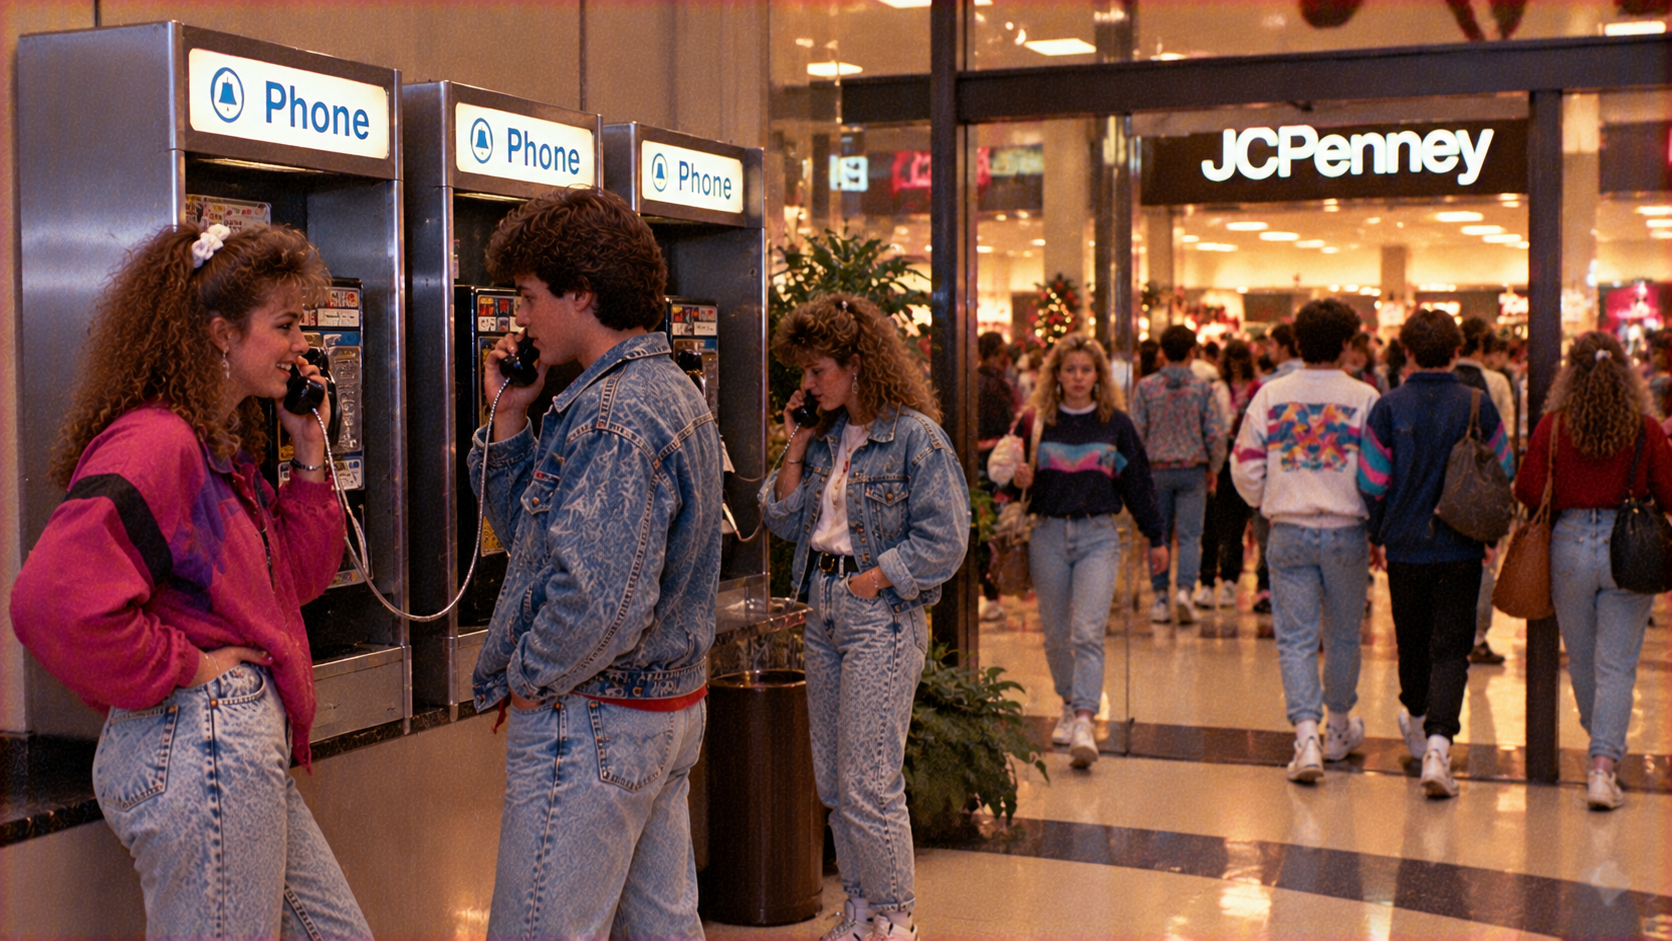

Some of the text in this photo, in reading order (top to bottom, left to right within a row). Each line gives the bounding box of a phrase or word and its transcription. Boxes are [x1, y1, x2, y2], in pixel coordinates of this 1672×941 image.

[265, 80, 370, 140] Phone
[507, 127, 580, 176] Phone
[1201, 125, 1495, 186] JCPenney
[678, 160, 732, 200] Phone
